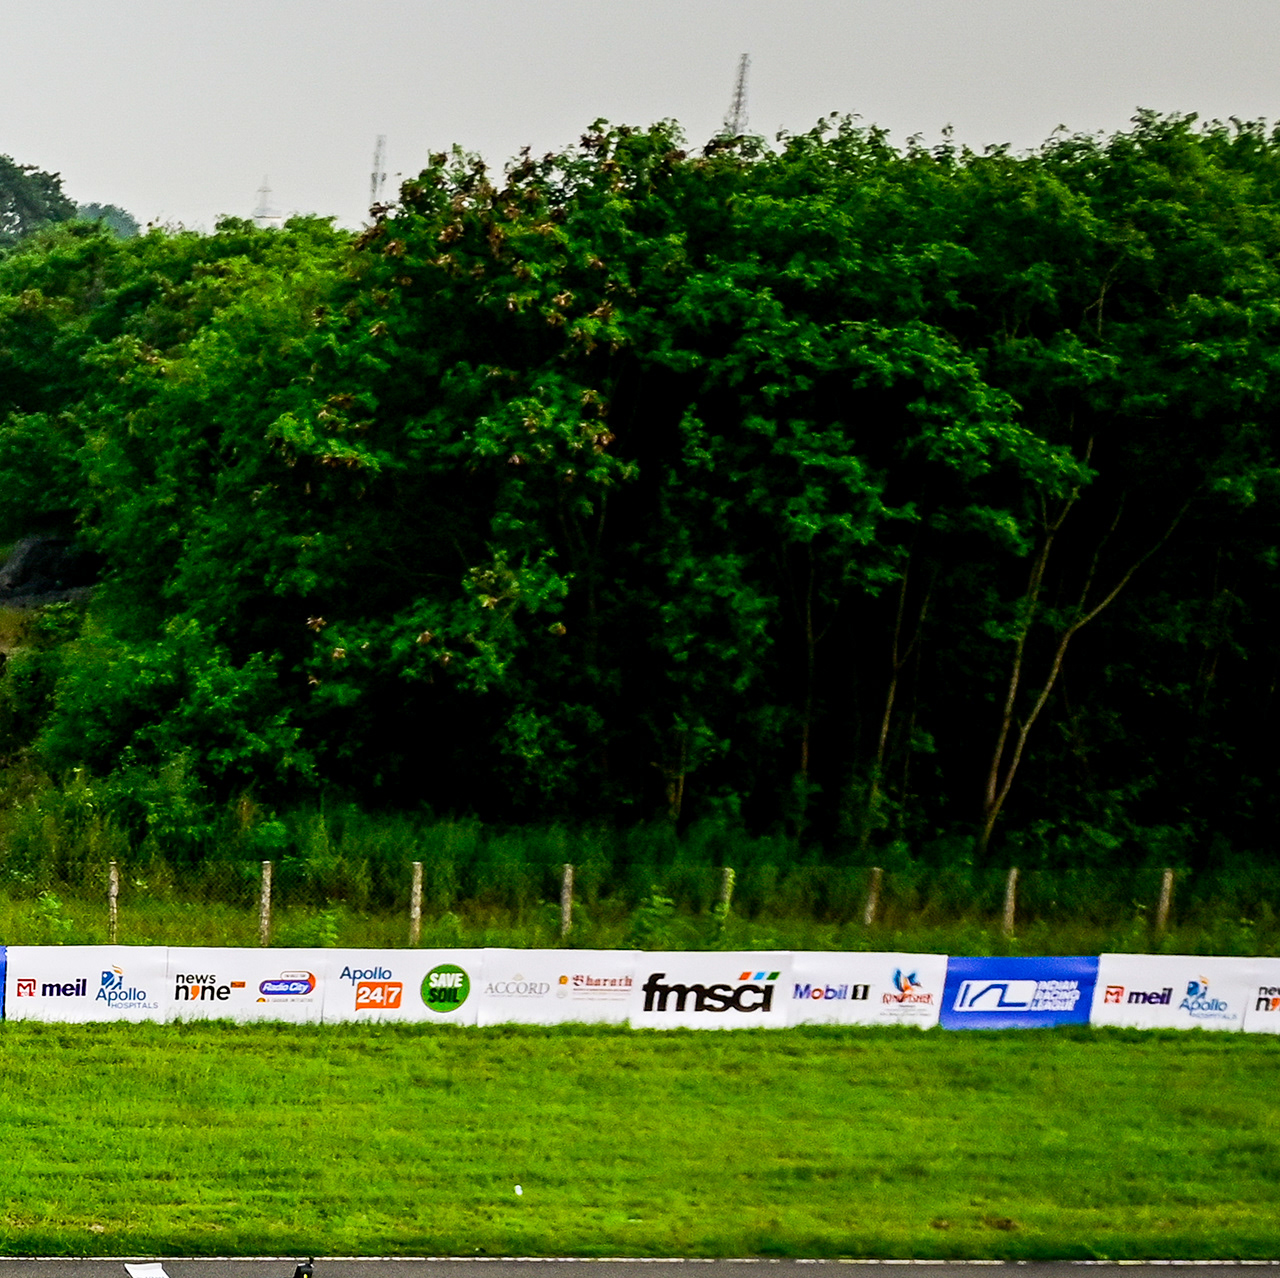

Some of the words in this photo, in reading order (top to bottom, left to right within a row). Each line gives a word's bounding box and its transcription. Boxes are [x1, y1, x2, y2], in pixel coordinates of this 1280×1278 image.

[175, 973, 217, 984] news
[340, 965, 392, 986] Apollo
[429, 972, 463, 988] SAVE
[41, 979, 87, 997] meil
[262, 980, 287, 993] Radio
[288, 981, 310, 995] City
[485, 982, 550, 995] ACCORD
[643, 973, 775, 1012] fmsci
[793, 984, 848, 1001] Mobil
[1037, 980, 1079, 991] INDIAN
[95, 988, 147, 1008] Apollo
[428, 988, 461, 1004] SOIL
[1034, 990, 1081, 1002] RACING
[1127, 988, 1173, 1005] meil
[1179, 996, 1228, 1017] Apollo
